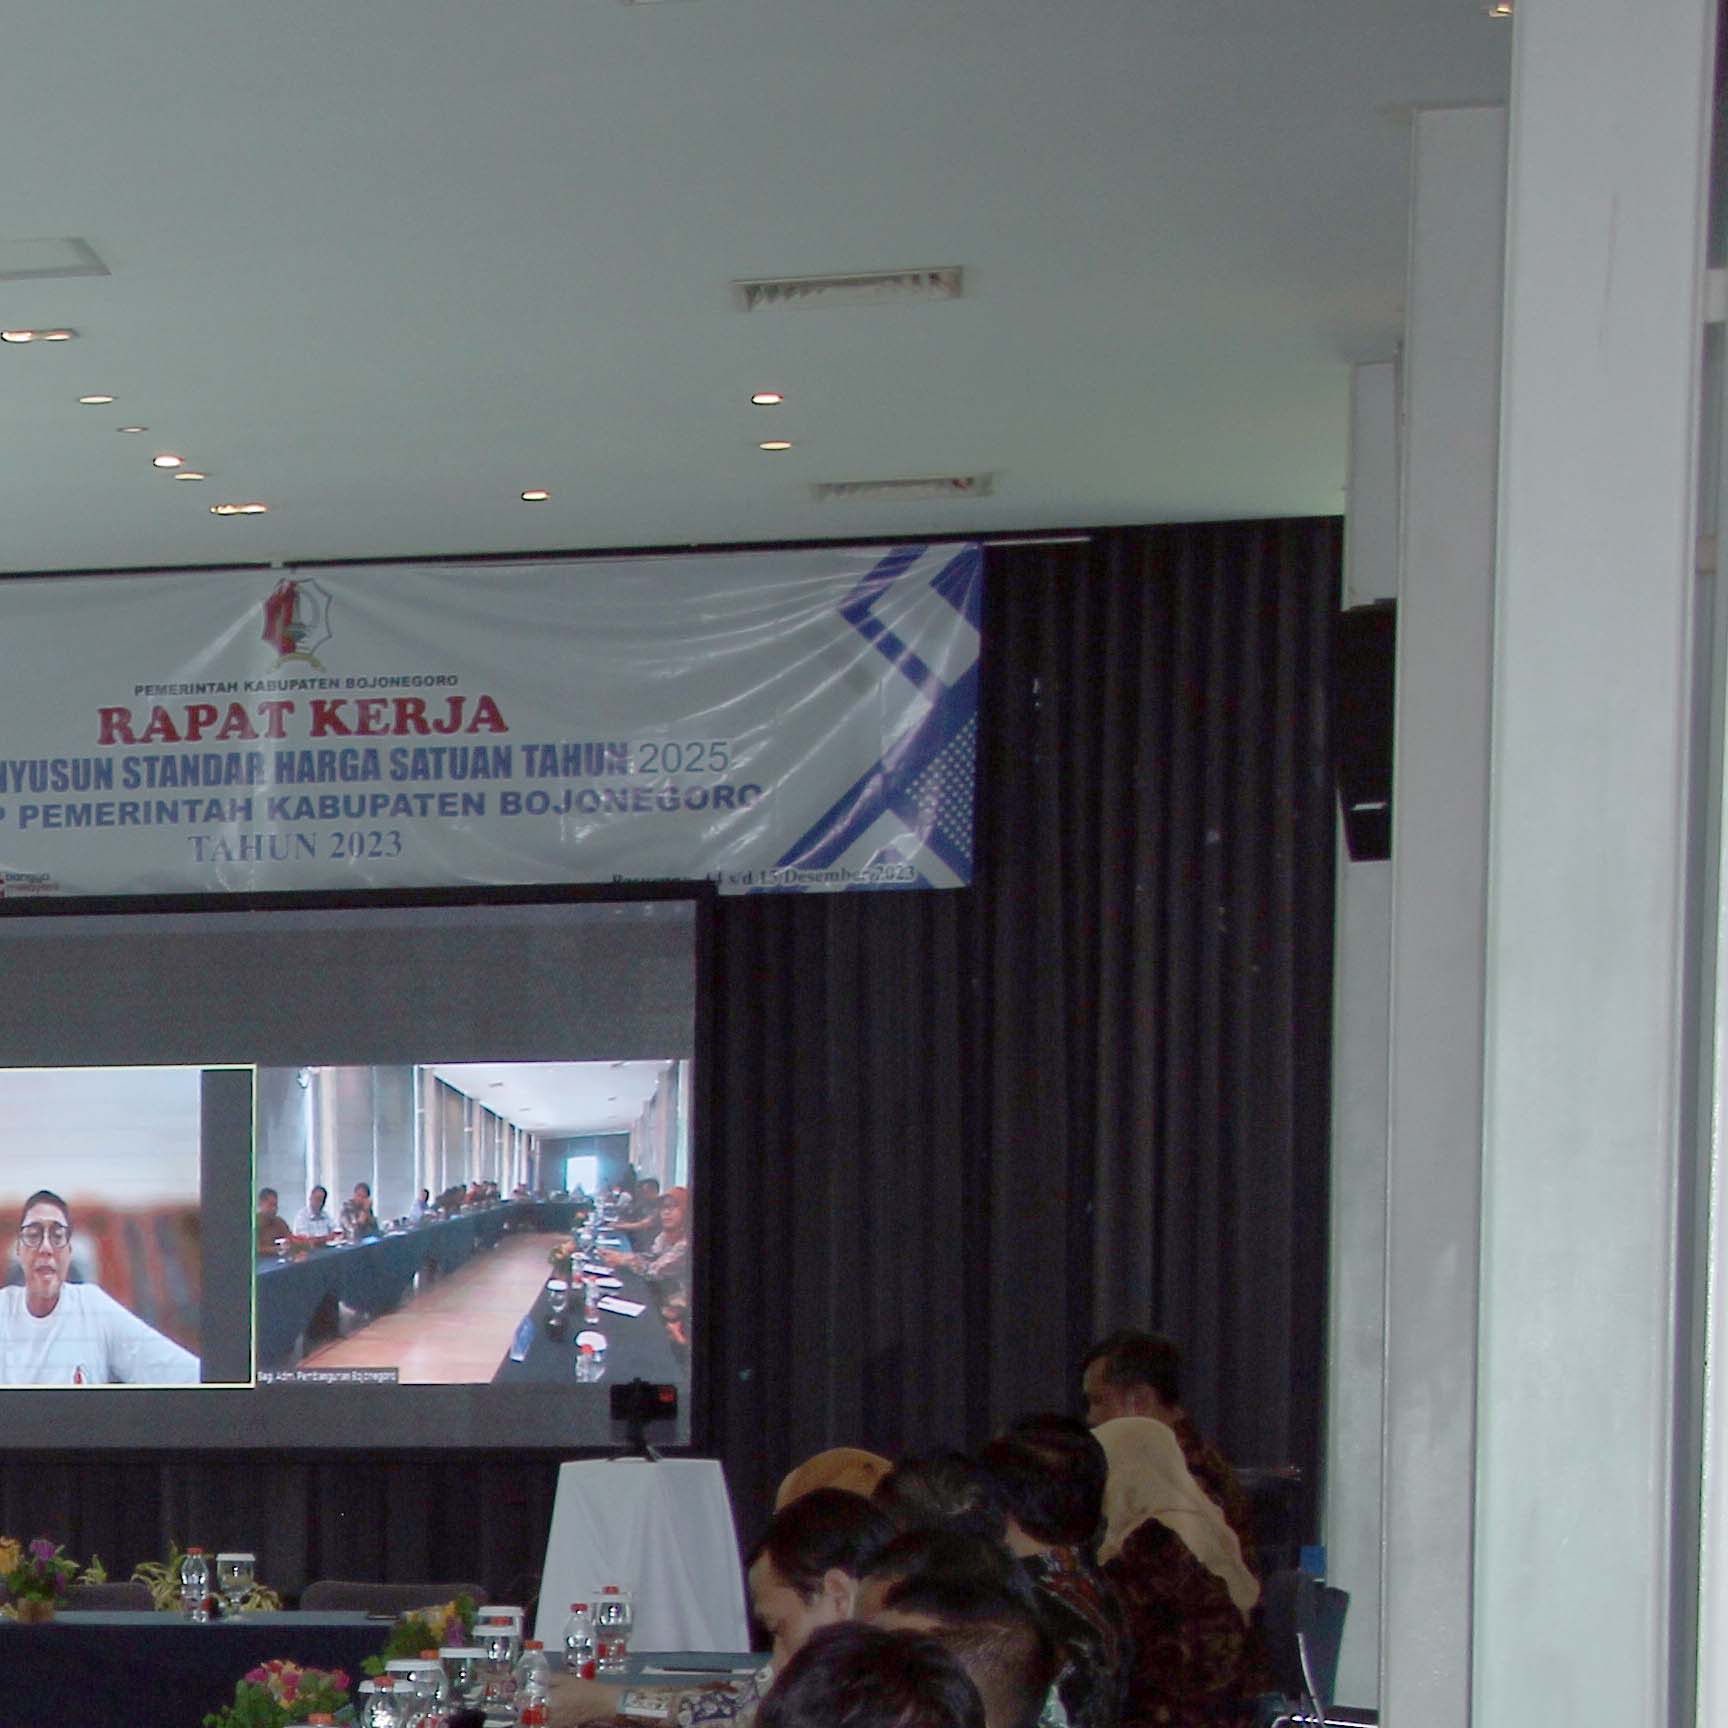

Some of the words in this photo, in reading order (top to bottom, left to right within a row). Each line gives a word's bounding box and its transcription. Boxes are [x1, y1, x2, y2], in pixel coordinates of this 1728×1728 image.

[134, 681, 238, 697] PEMERINTAH
[244, 677, 340, 692] KABUPATEN
[345, 674, 459, 690] BOJONEGORO
[97, 700, 295, 746] RAPAT
[310, 694, 509, 738] KERJA
[122, 751, 268, 791] STANDAR
[275, 747, 381, 785] HARGA
[389, 744, 512, 781] SATUAN
[521, 742, 628, 779] TAHUN
[638, 741, 729, 775] 2025
[19, 798, 253, 830] PEMERINTAH
[269, 791, 486, 820] KABUPATEN
[500, 784, 763, 817] BOJONEGORO
[188, 832, 316, 863] TAHUN
[330, 830, 402, 860] 2023
